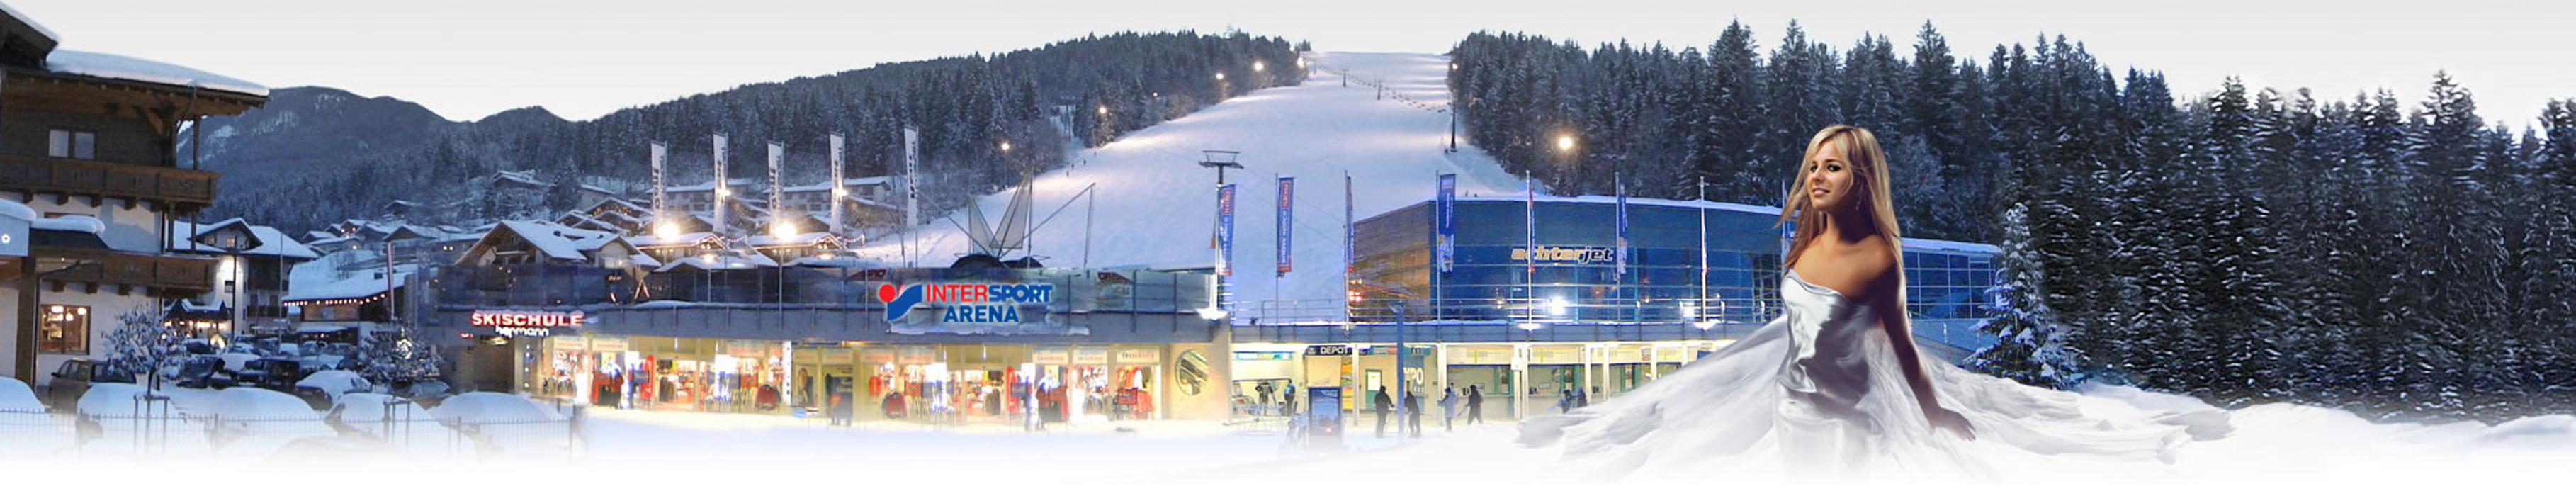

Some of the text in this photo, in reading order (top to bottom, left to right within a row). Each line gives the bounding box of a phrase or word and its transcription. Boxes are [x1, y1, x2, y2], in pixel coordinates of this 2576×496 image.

[927, 283, 1053, 303] INTERSPORT
[471, 312, 584, 327] SKISCHULE
[943, 305, 1019, 323] ARENA
